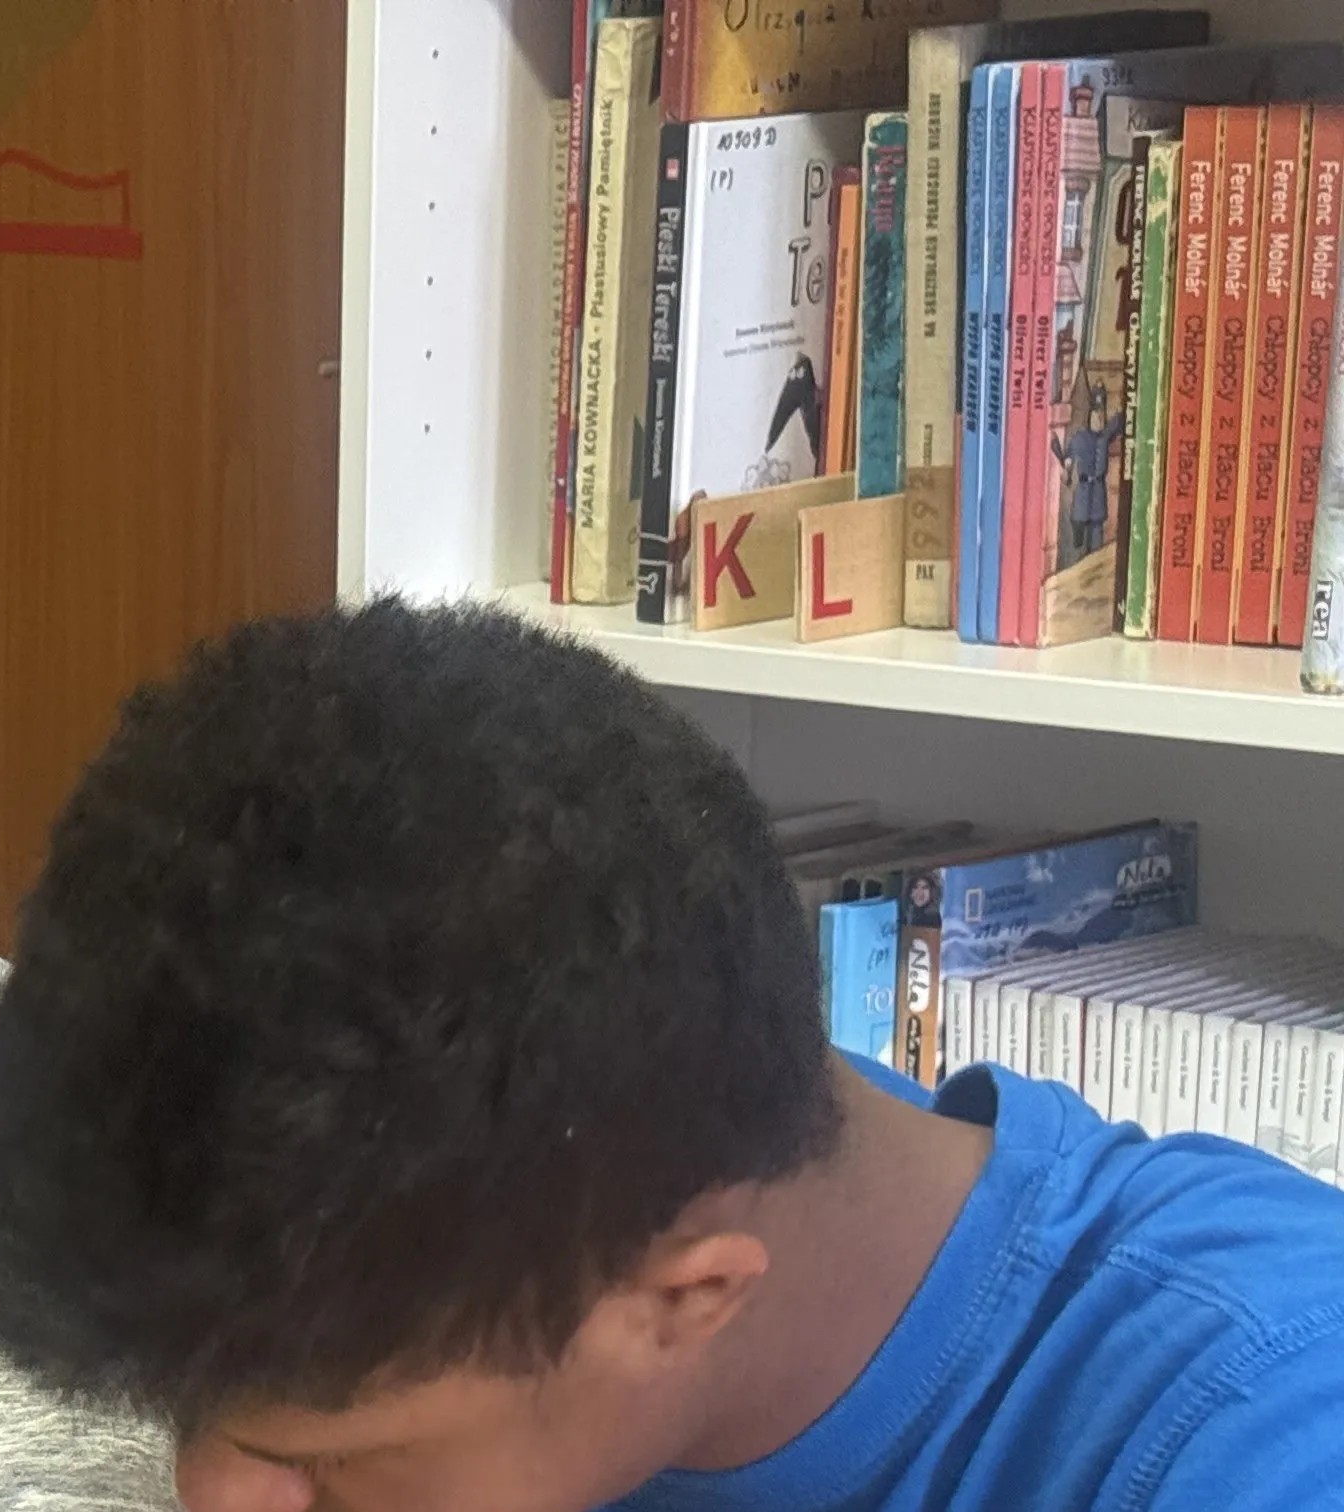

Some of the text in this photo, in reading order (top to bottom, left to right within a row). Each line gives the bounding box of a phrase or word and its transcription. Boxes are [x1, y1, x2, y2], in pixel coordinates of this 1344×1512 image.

[1315, 160, 1340, 226] Ferenc
[589, 204, 611, 318] Plastusiowy
[1310, 234, 1335, 300] Molnár
[1014, 313, 1028, 362] Oliver
[1036, 314, 1050, 363] Oliver
[1171, 159, 1212, 570] Ferenc Molnár Chłopcy z Placu Broni
[1211, 161, 1252, 573] Ferenc Molnár Chłopcy z Placu Broni
[1250, 159, 1294, 574] Ferenc Molnár Chłopcy z Placu Broni
[584, 336, 602, 458] KOWNACKA
[1011, 368, 1026, 410] Twist
[1033, 369, 1048, 411] Twist
[580, 465, 597, 529] MARIA
[702, 511, 756, 609] K
[811, 531, 853, 621] L
